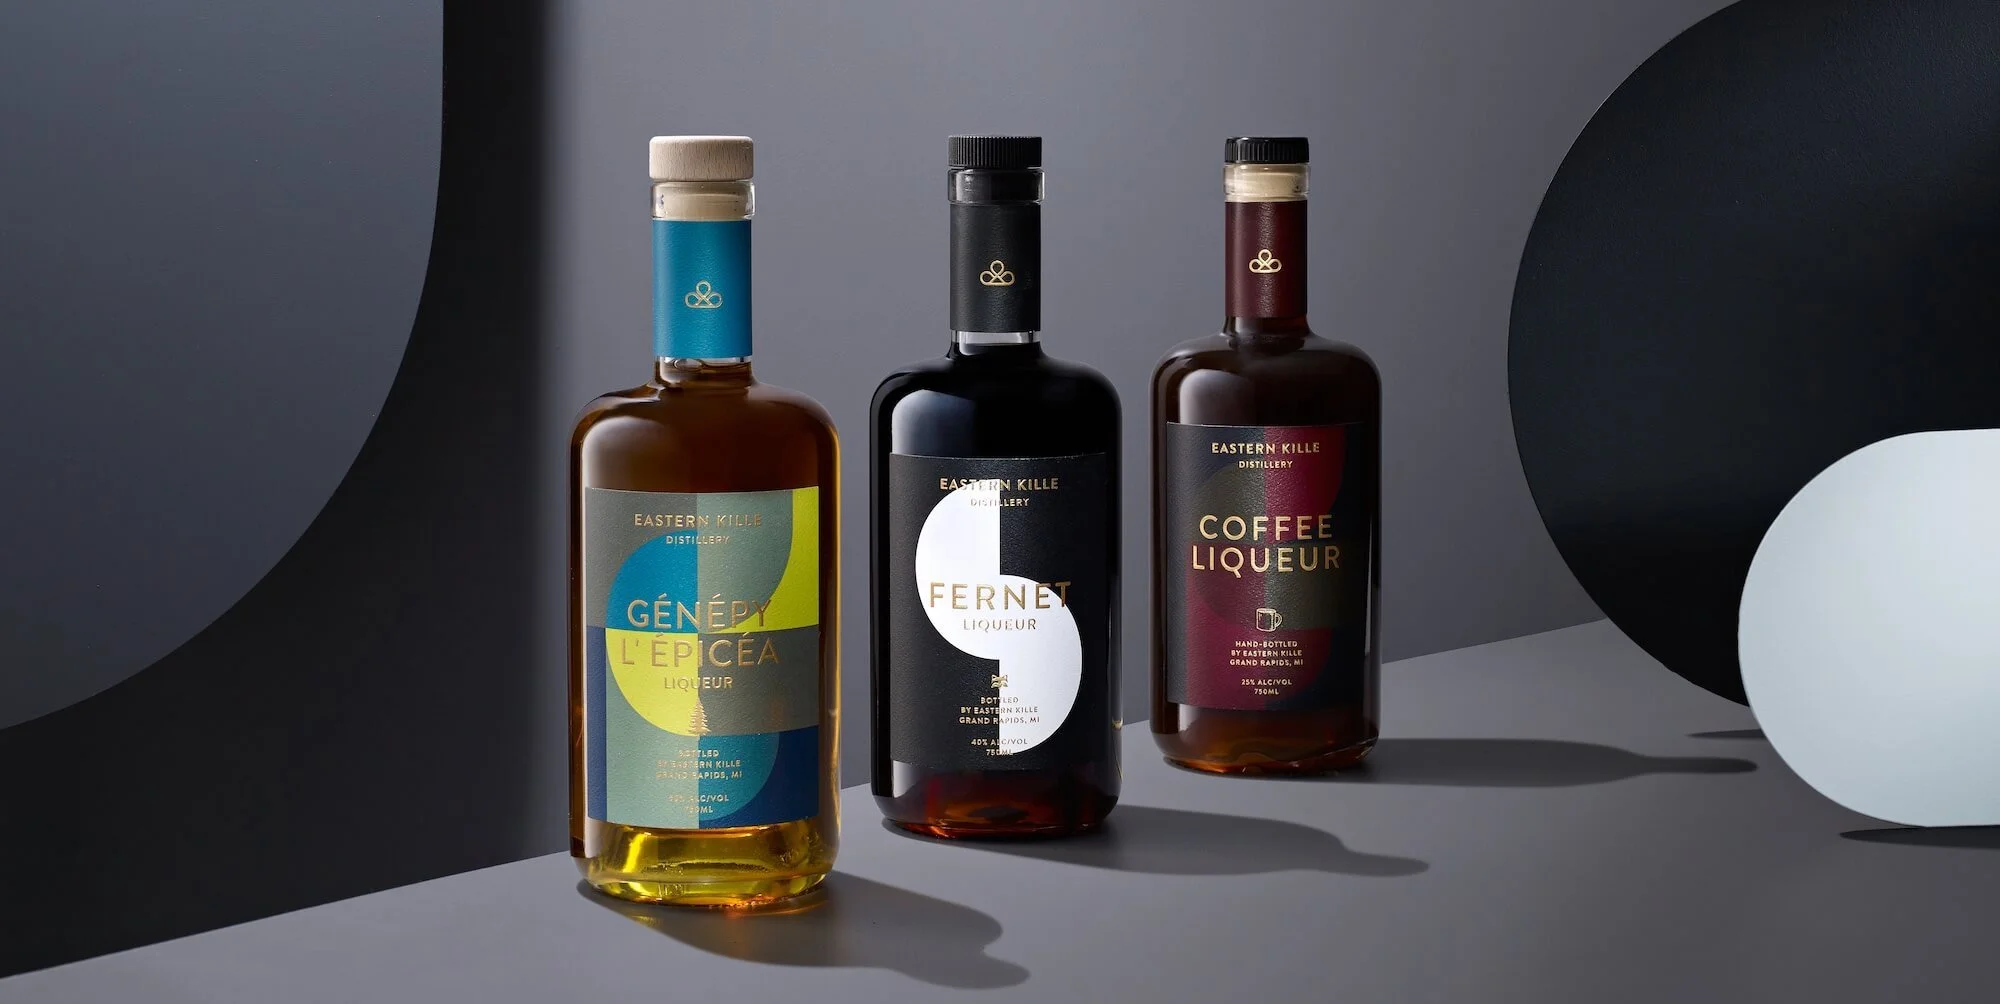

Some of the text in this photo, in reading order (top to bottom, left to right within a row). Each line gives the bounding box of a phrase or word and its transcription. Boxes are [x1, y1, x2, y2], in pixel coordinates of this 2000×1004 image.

[1212, 442, 1320, 454] EASTERN KILLE
[1238, 460, 1293, 469] DISTILLERY
[939, 478, 1059, 491] EASTERN KILLE
[970, 498, 1030, 507] DISTILLERY
[634, 513, 762, 528] EASTERN KILLE
[1199, 514, 1332, 541] COFFEE
[665, 535, 730, 545] DISTILLERY
[1192, 545, 1340, 579] LIQUEUR
[930, 581, 1072, 610] FERNET
[627, 592, 772, 629] GÉNÉPY
[963, 618, 1037, 633] LIQUEUR
[1235, 640, 1298, 648] HAND-BOTTLED
[1231, 649, 1303, 658] BY EASTERN KILLE
[1260, 659, 1292, 667] RAPIDS,
[1293, 658, 1304, 666] MI
[664, 676, 733, 692] LIQUEUR
[1241, 678, 1292, 686] 25% ALC/VOL
[980, 696, 1019, 704] BOTTLED
[960, 706, 972, 714] BY
[973, 706, 1012, 715] EASTERN
[959, 716, 990, 725] GRAND
[993, 717, 1028, 725] RAPIDS,
[971, 738, 1028, 746] 40% ALC/VOL
[679, 749, 720, 758] BOTTLED
[986, 748, 1014, 756] 750ML
[715, 759, 742, 769] KILLE
[692, 771, 729, 781] RAPIDS,
[731, 770, 743, 779] MI
